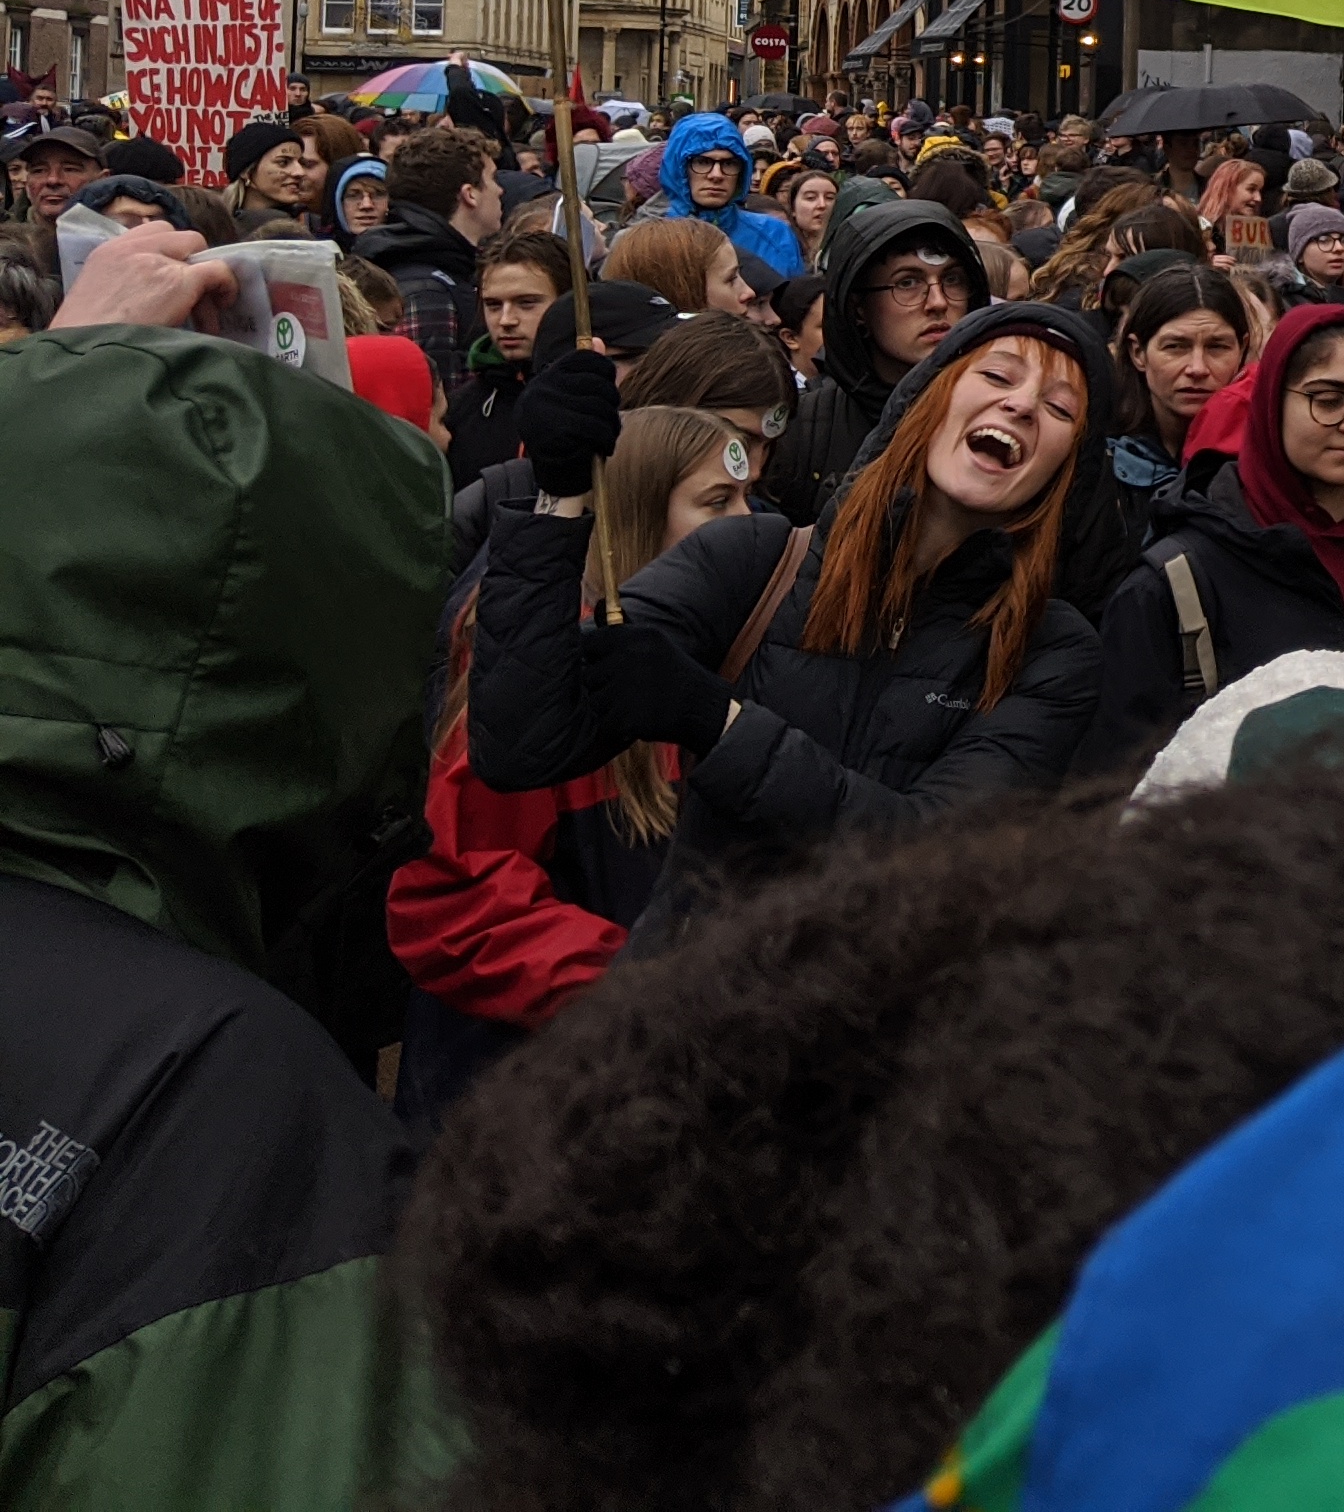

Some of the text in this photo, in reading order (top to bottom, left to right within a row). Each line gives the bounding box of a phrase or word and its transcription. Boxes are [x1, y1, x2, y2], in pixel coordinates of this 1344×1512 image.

[124, 24, 190, 65] SUCH
[754, 37, 787, 47] COSTA
[126, 67, 288, 111] ICE HOW CAN
[129, 105, 182, 144] YOU
[186, 107, 251, 145] NOT
[0, 1133, 63, 1199] ORTH
[27, 1120, 86, 1170] THE
